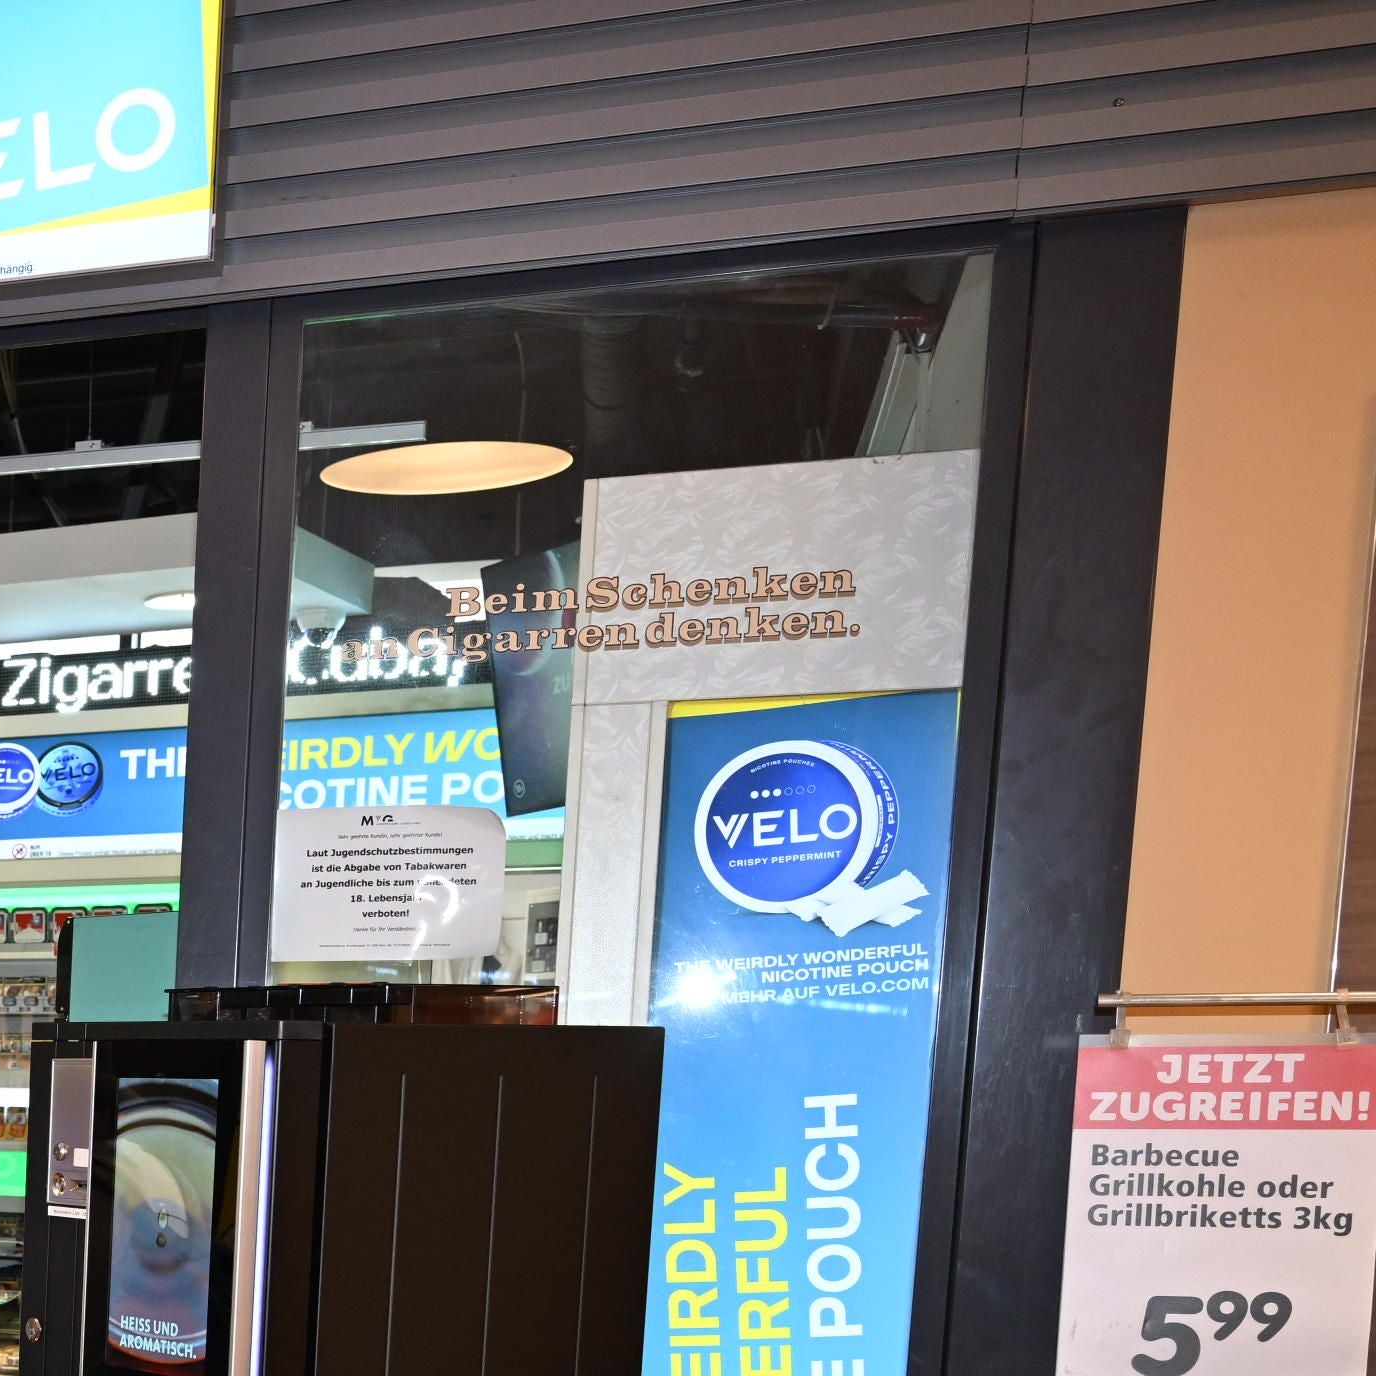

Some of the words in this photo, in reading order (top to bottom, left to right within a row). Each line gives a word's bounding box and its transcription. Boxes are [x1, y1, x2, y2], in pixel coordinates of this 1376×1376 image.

[445, 584, 578, 620] Beim
[585, 565, 856, 610] Schenken
[341, 636, 399, 662] an
[406, 616, 640, 664] Cigarren
[645, 606, 861, 648] denken.
[0, 650, 192, 713] Zigarre
[280, 732, 416, 772] IRDLY
[423, 727, 501, 764] WO
[40, 761, 97, 783] VELO
[750, 759, 781, 774] NICOTINE
[783, 757, 815, 768] POUCHES
[278, 773, 429, 811] COTINE
[441, 769, 506, 806] PO
[713, 803, 858, 849] VELO
[306, 848, 329, 858] Laut
[331, 846, 474, 858] Jugendschutzbestimmungen
[728, 856, 768, 868] CRISPY
[771, 850, 842, 865] PEPPERMINT
[311, 863, 324, 873] ist
[326, 862, 342, 873] die
[344, 862, 381, 875] Abgabe
[383, 864, 402, 872] von
[404, 861, 467, 872] Tabakwaren
[300, 880, 313, 889] an
[315, 878, 374, 891] Jugendliche
[376, 877, 391, 888] bis
[393, 879, 415, 887] zum
[350, 894, 366, 904] 18.
[362, 908, 410, 919] verboten!
[717, 953, 800, 971] WEIRDLY
[803, 943, 929, 966] WONDERFUL
[762, 964, 853, 983] NICOTINE
[858, 959, 930, 976] POUCH
[720, 990, 777, 1004] MEHR
[783, 986, 820, 1000] AUF
[825, 977, 930, 997] VELO.COM
[1156, 1052, 1306, 1084] JETZT
[1088, 1090, 1371, 1122] ZUGREIFEN!
[1090, 1143, 1240, 1168] Barbecue
[1088, 1172, 1246, 1198] Grillkohle
[1256, 1174, 1335, 1200] oder
[804, 1092, 864, 1338] POUCH
[1087, 1203, 1282, 1230] Grillbriketts
[1293, 1206, 1354, 1237] 3kg
[120, 1315, 151, 1333] HEISS
[153, 1320, 179, 1337] UND
[119, 1334, 198, 1360] AROMATISCH.
